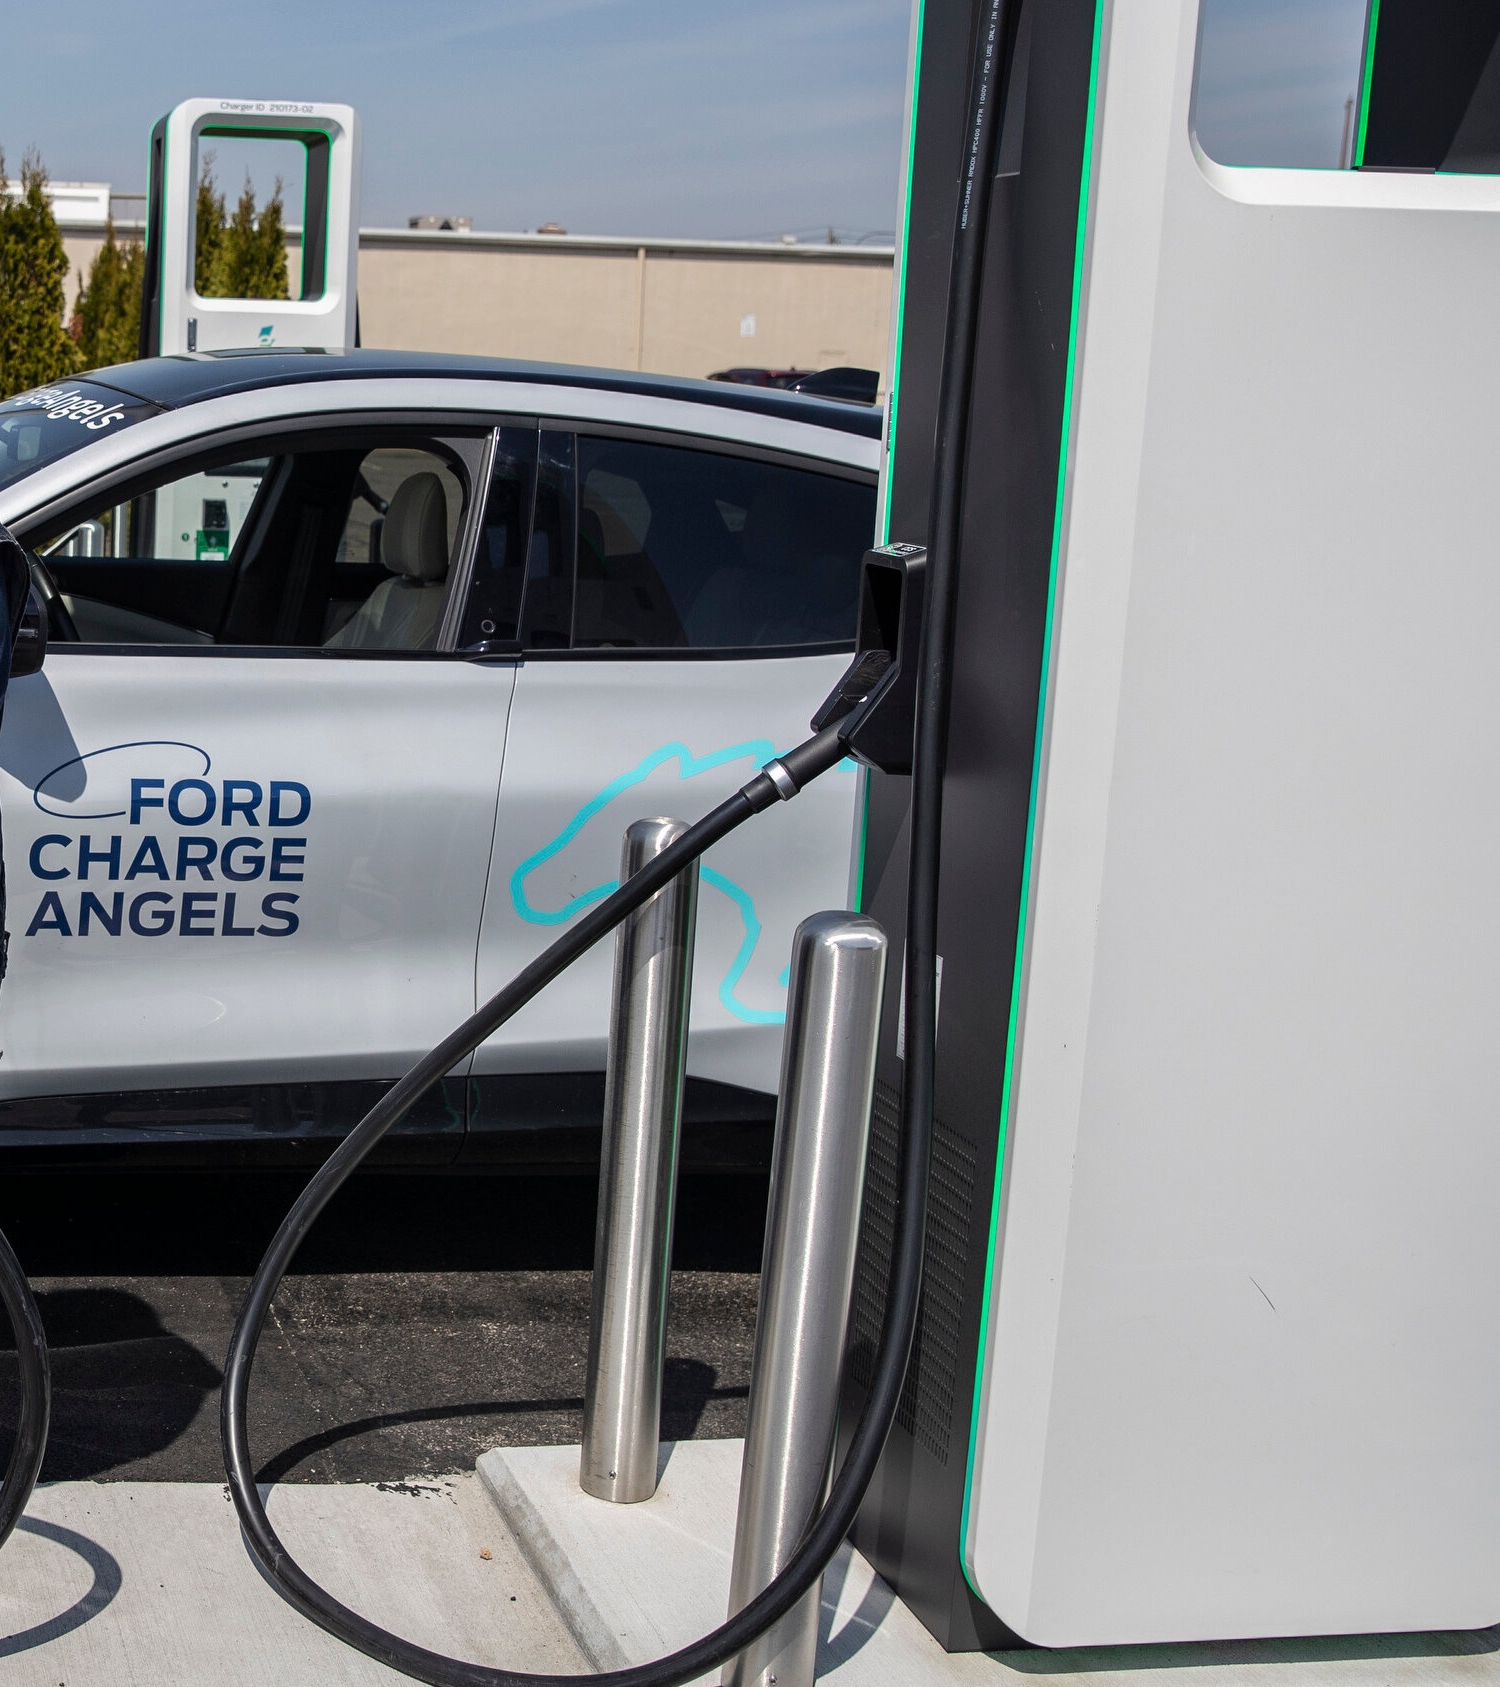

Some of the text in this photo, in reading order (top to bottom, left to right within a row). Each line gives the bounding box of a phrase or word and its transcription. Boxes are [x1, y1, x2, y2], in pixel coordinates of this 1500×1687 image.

[220, 102, 314, 113] Charger ID 210173-02
[968, 156, 976, 177] RADOX
[991, 11, 997, 20] IN
[129, 778, 311, 826] FORD
[28, 833, 308, 882] CHARGE
[25, 889, 301, 938] ANGELS
